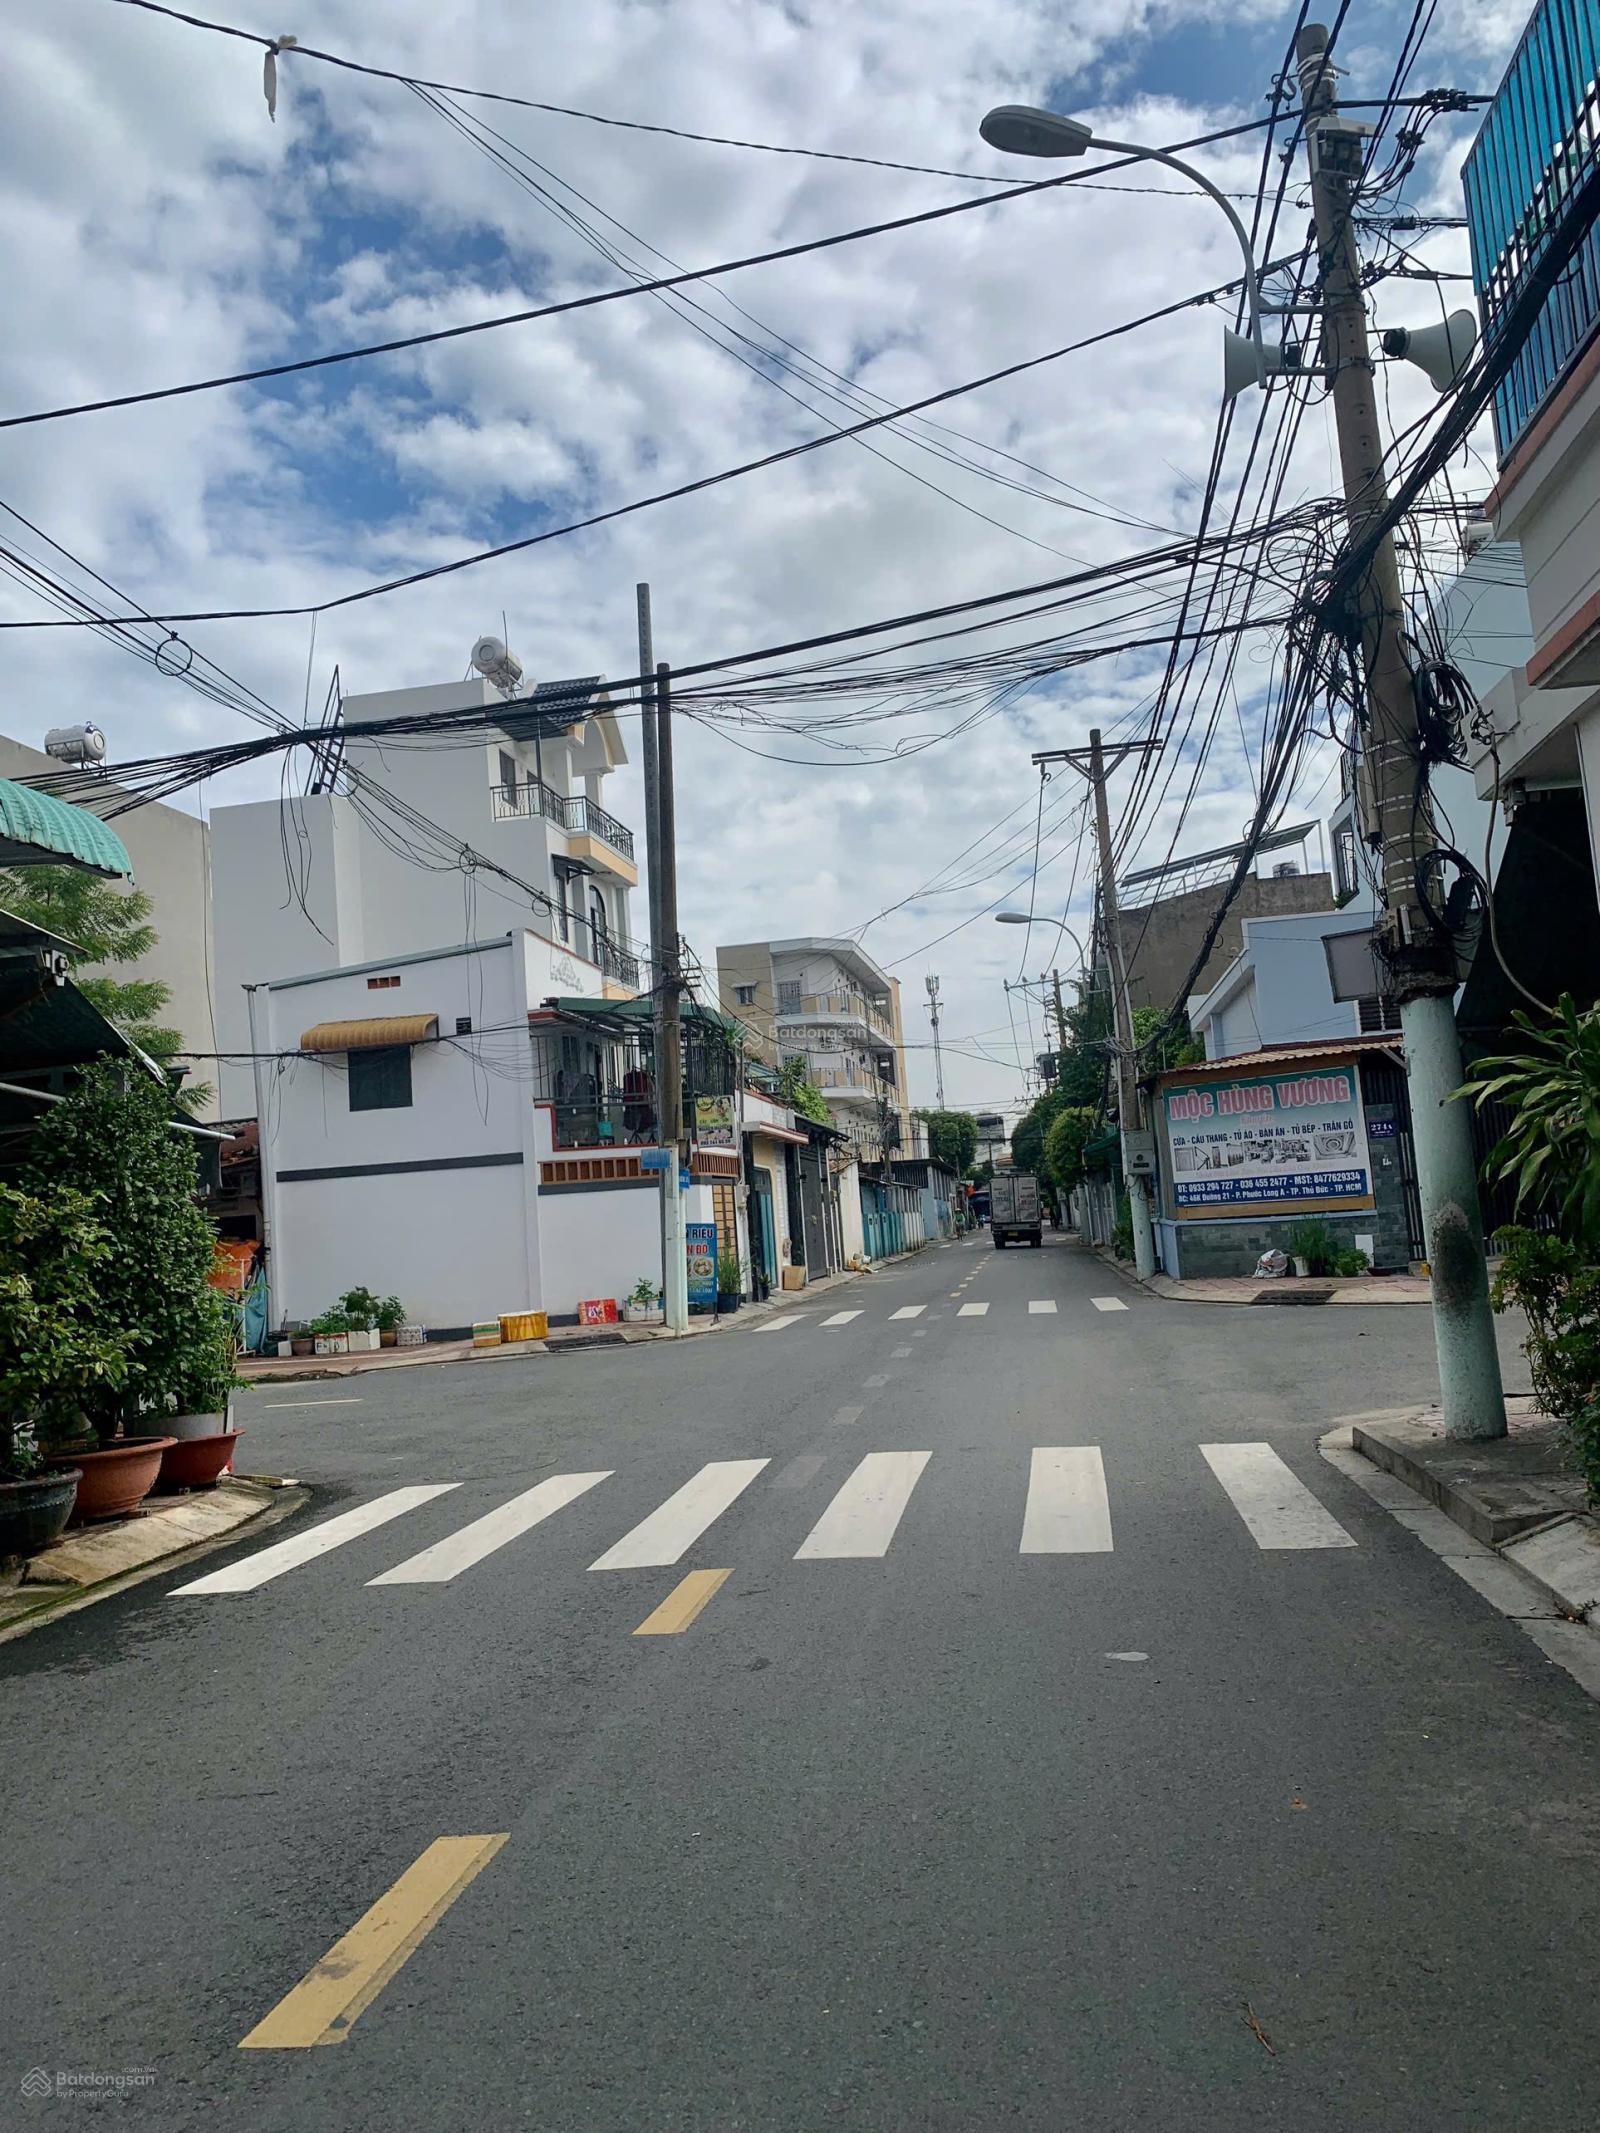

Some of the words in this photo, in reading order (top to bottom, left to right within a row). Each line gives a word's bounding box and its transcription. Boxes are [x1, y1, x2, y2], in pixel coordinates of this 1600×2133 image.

[1169, 1089, 1213, 1123] MỘC
[1217, 1084, 1274, 1115] HÙNG
[1276, 1076, 1350, 1108] VƯƠNG
[1206, 1132, 1228, 1143] THANG
[1233, 1128, 1242, 1140] TỦ
[1291, 1123, 1300, 1135] TỦ
[1220, 1181, 1233, 1190] 727
[1255, 1178, 1268, 1188] 455
[1269, 1177, 1287, 1187] 2477
[1294, 1175, 1313, 1185] MST:
[1263, 1189, 1279, 1198] Long
[1280, 1188, 1285, 1196] A
[1345, 1183, 1361, 1191] HCM
